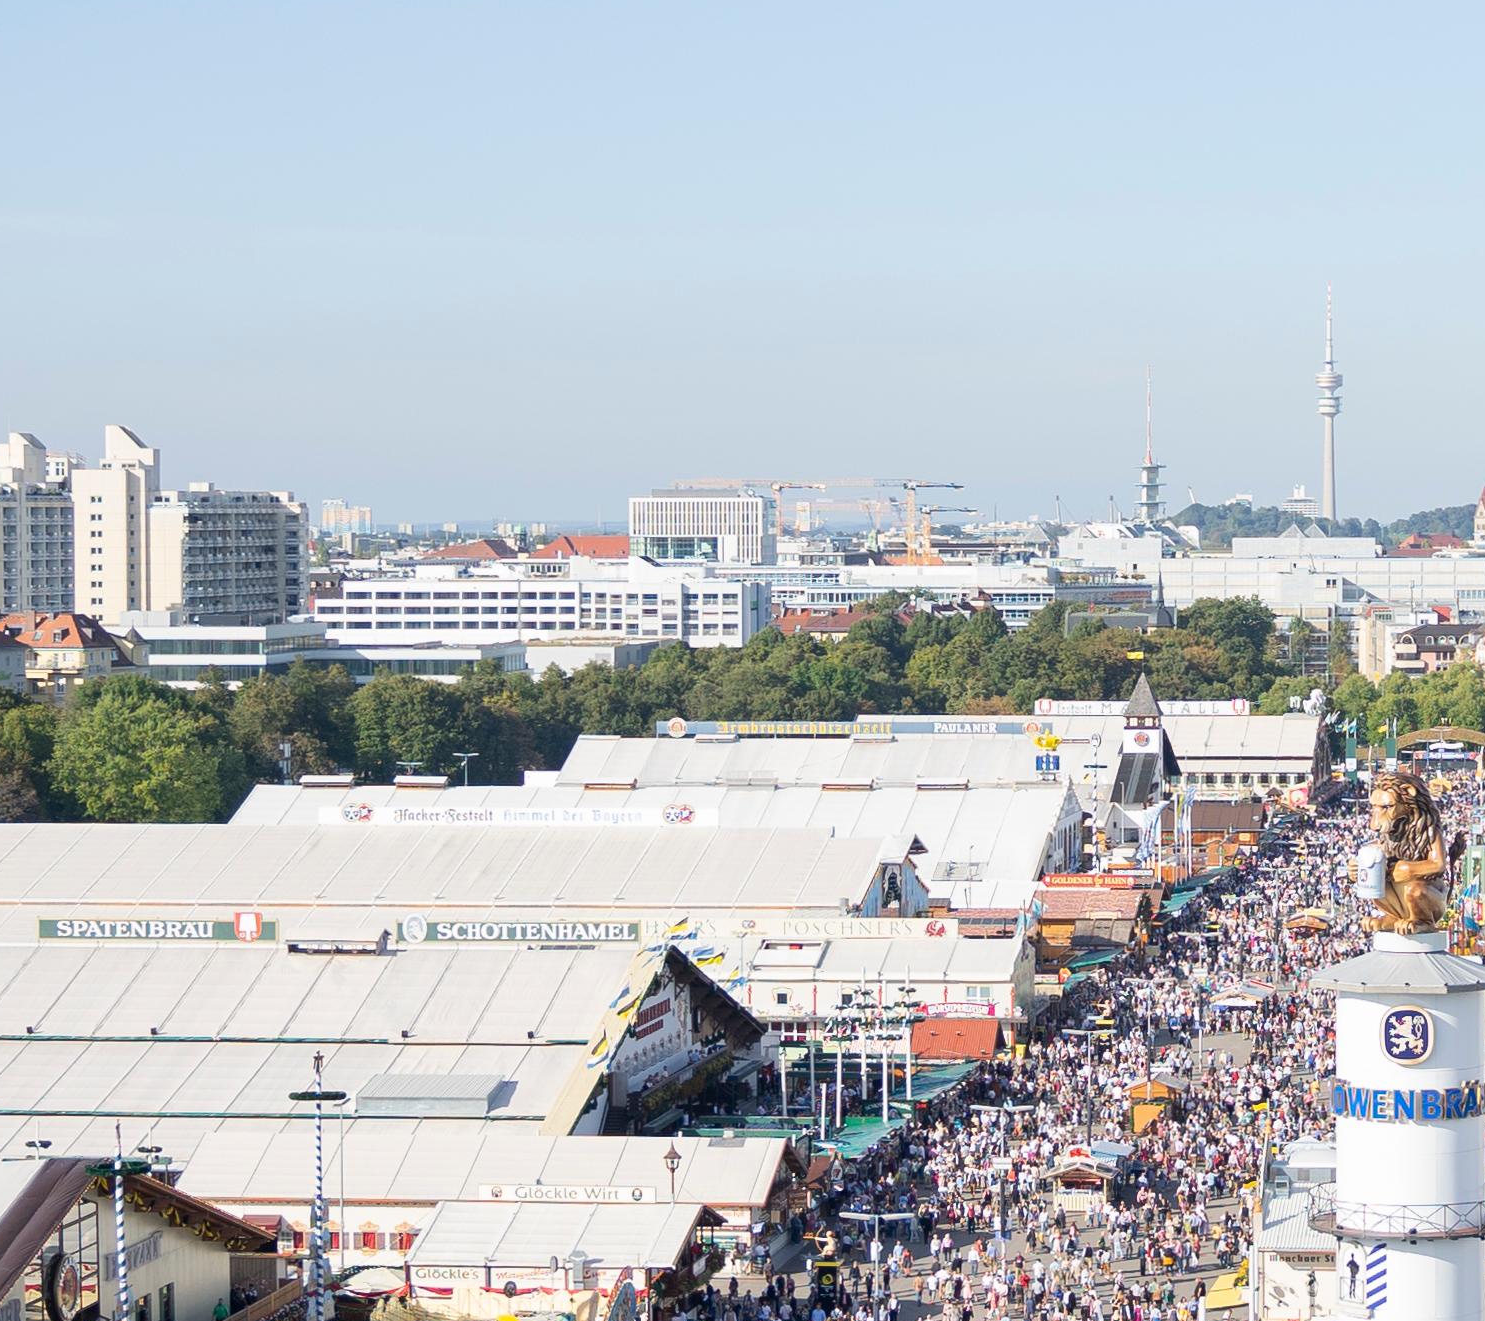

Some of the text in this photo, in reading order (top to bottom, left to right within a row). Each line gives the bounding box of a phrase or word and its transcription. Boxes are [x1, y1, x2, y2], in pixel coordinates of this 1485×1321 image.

[934, 722, 997, 733] PAULANER
[56, 918, 638, 941] SPATENBRÄU SCHOTTENHAMEL
[515, 1186, 619, 1200] Glöckle Wirt
[415, 1268, 479, 1280] Glöckle's
